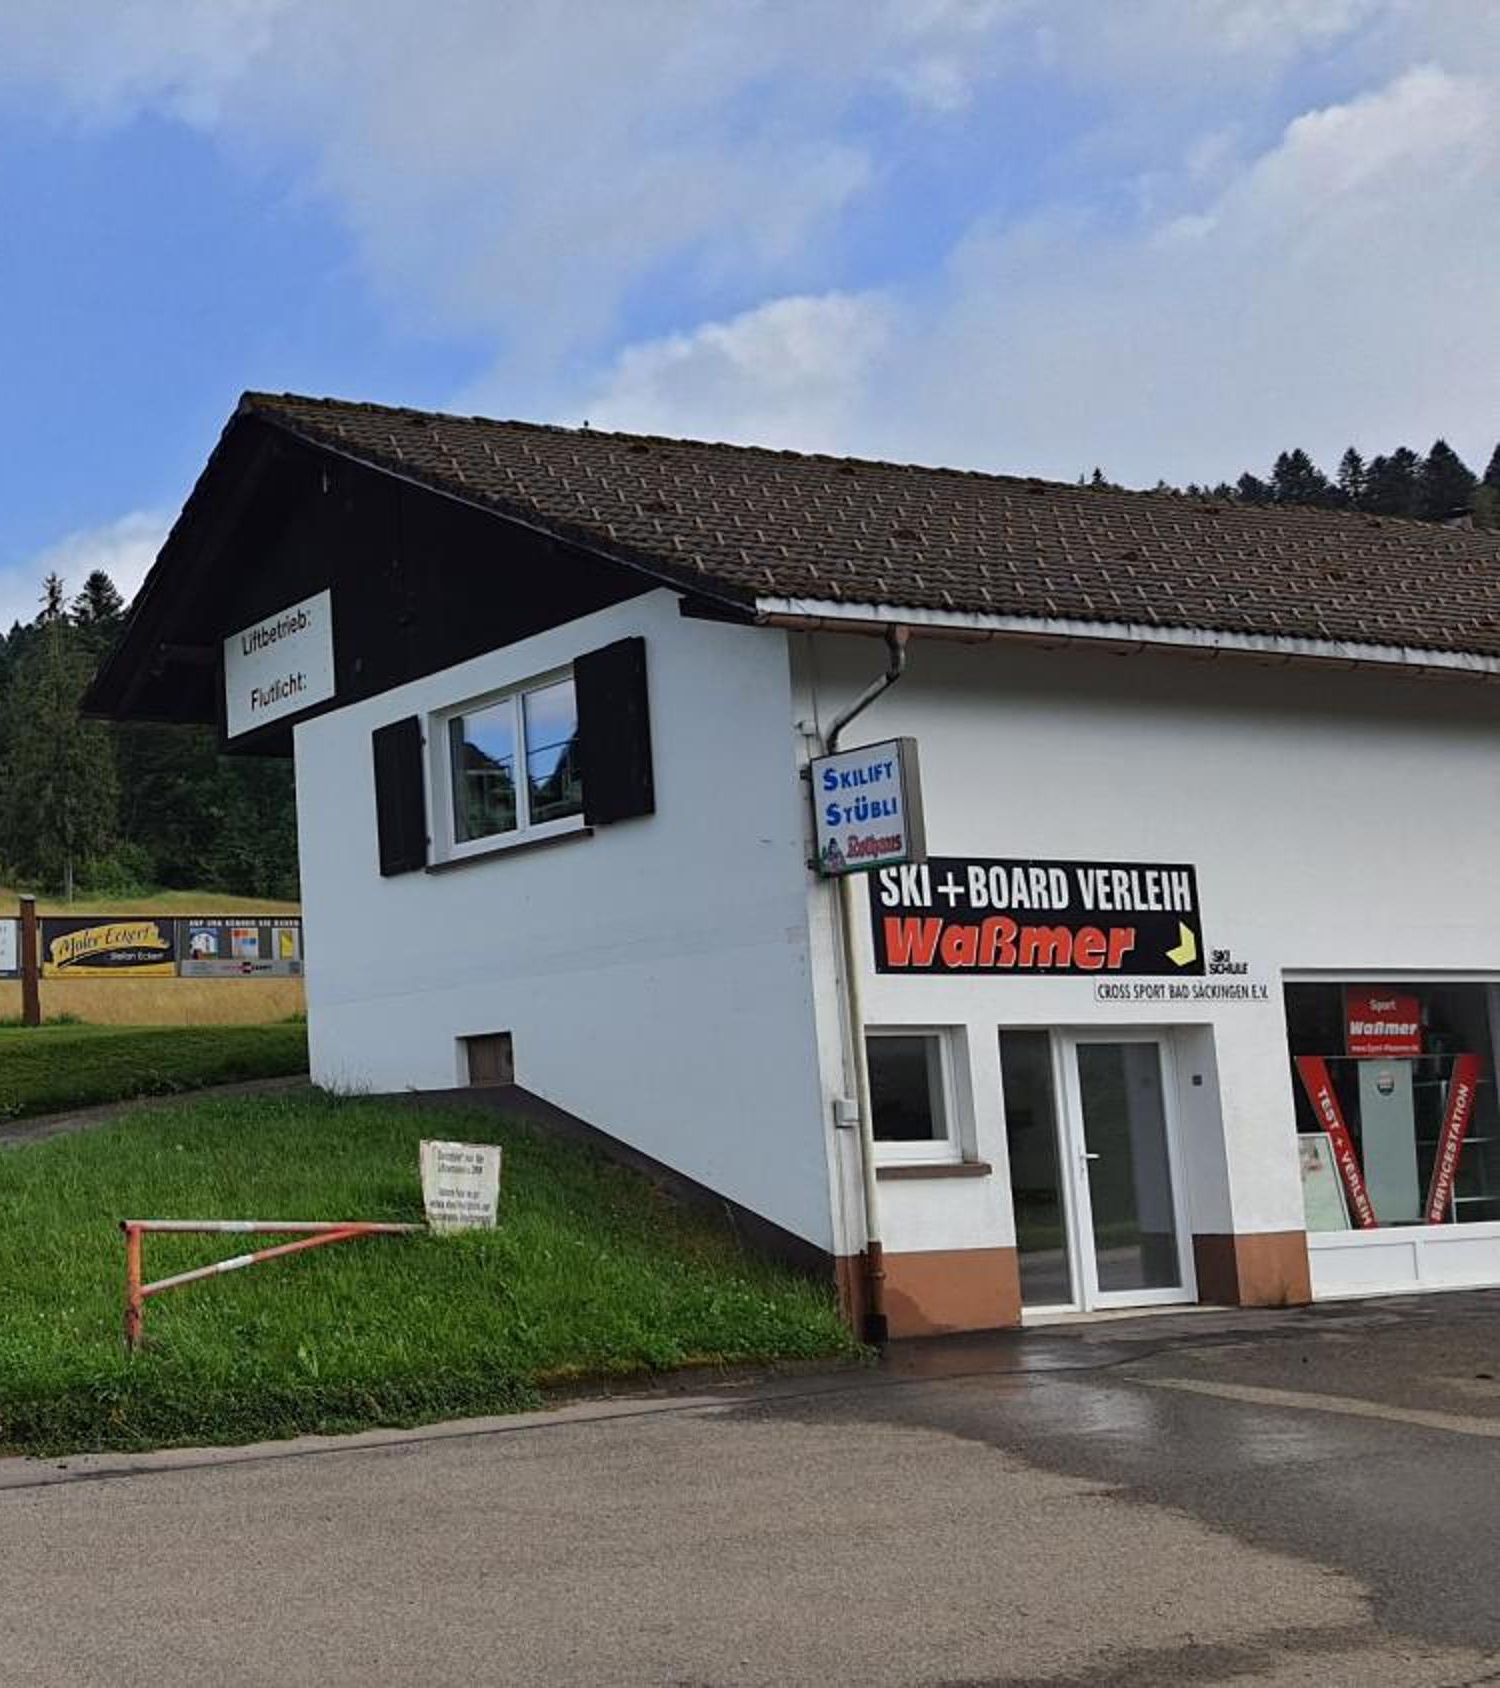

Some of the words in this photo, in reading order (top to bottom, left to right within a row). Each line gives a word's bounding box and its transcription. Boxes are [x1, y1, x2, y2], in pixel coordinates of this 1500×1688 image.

[241, 608, 312, 657] Liftbetrieb:
[250, 671, 307, 712] Flutlicht:
[823, 761, 893, 791] SKILIFT
[826, 796, 898, 827] STÜBLI
[1075, 869, 1192, 912] VERLEIH
[883, 915, 1136, 970] Waßmer
[1097, 983, 1131, 999] CROSS
[1133, 983, 1166, 999] SPORT
[1169, 983, 1190, 999] BAD
[1318, 1086, 1339, 1129] TEST
[1342, 1151, 1373, 1226] VERLEIH
[1431, 1083, 1469, 1221] SERVICESTATION
